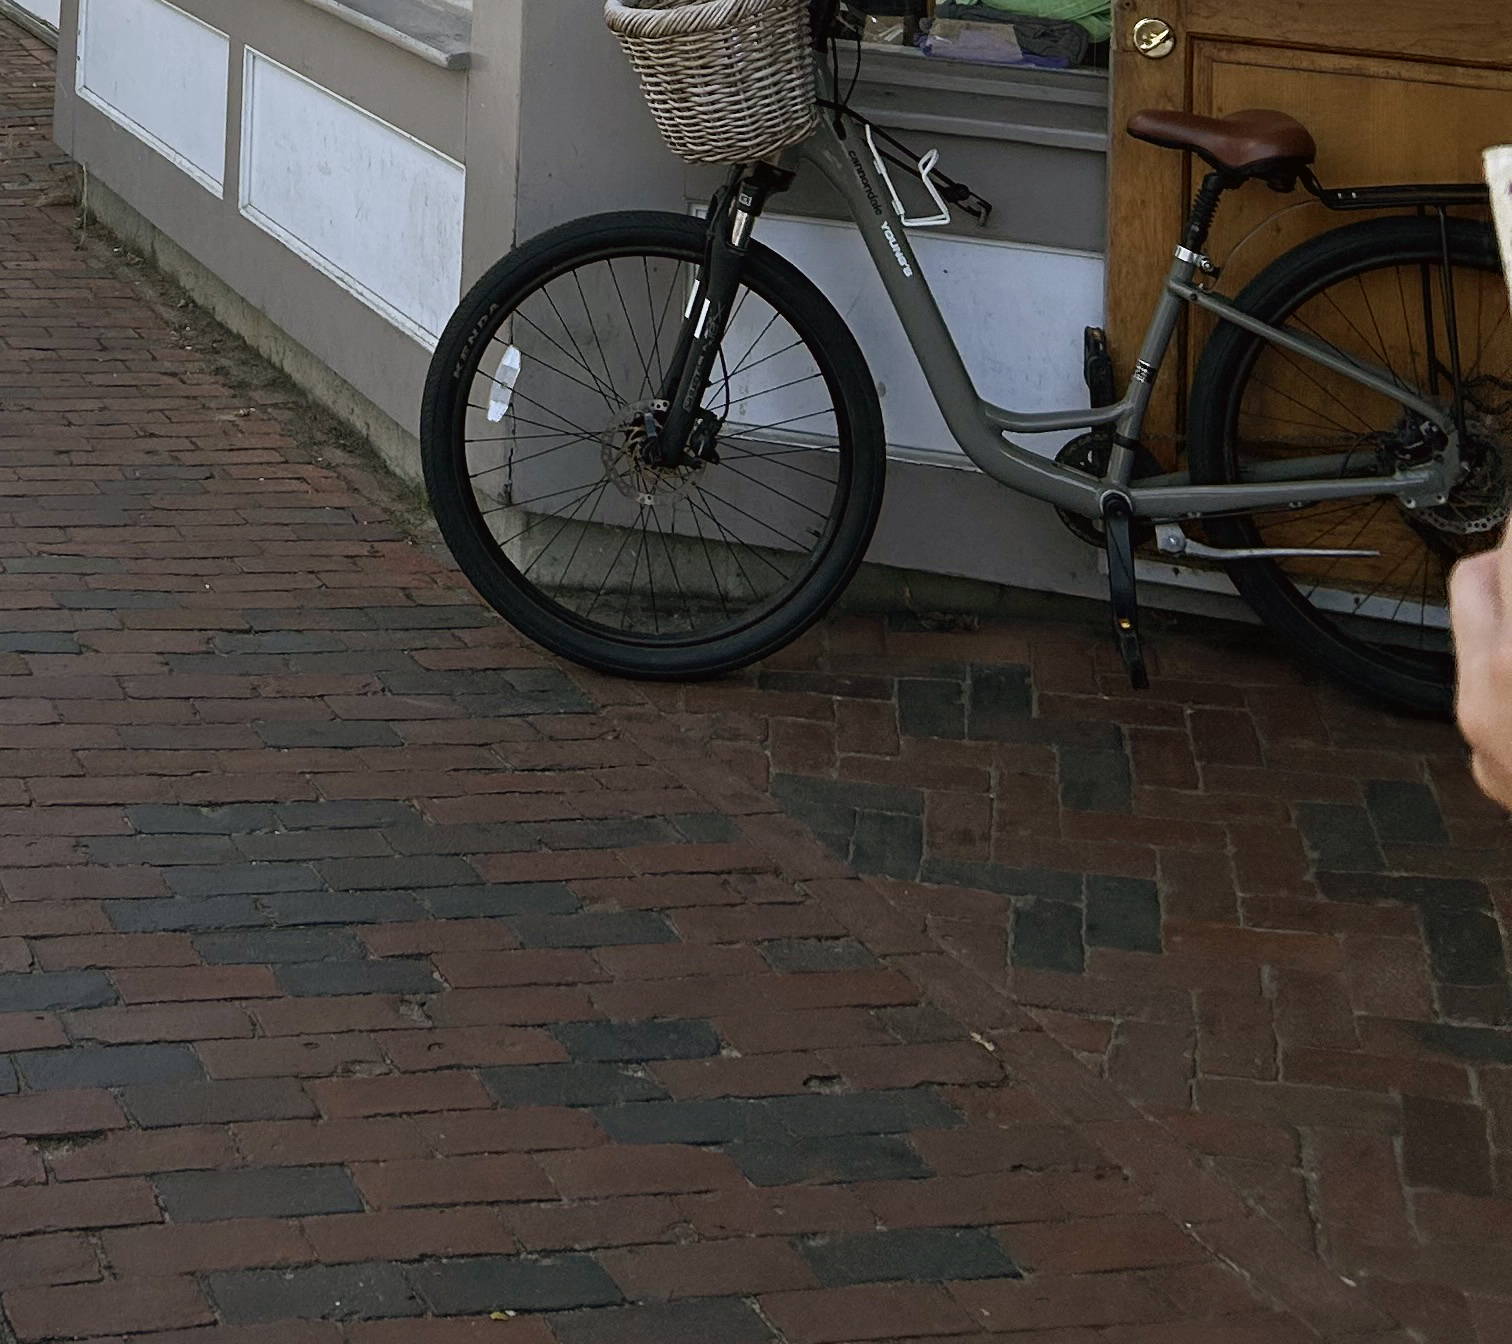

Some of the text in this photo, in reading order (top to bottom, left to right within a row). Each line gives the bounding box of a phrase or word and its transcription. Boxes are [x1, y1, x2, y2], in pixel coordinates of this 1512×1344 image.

[849, 150, 882, 216] cannondale
[881, 221, 913, 277] YOUNG'S
[453, 303, 499, 378] KENDA
